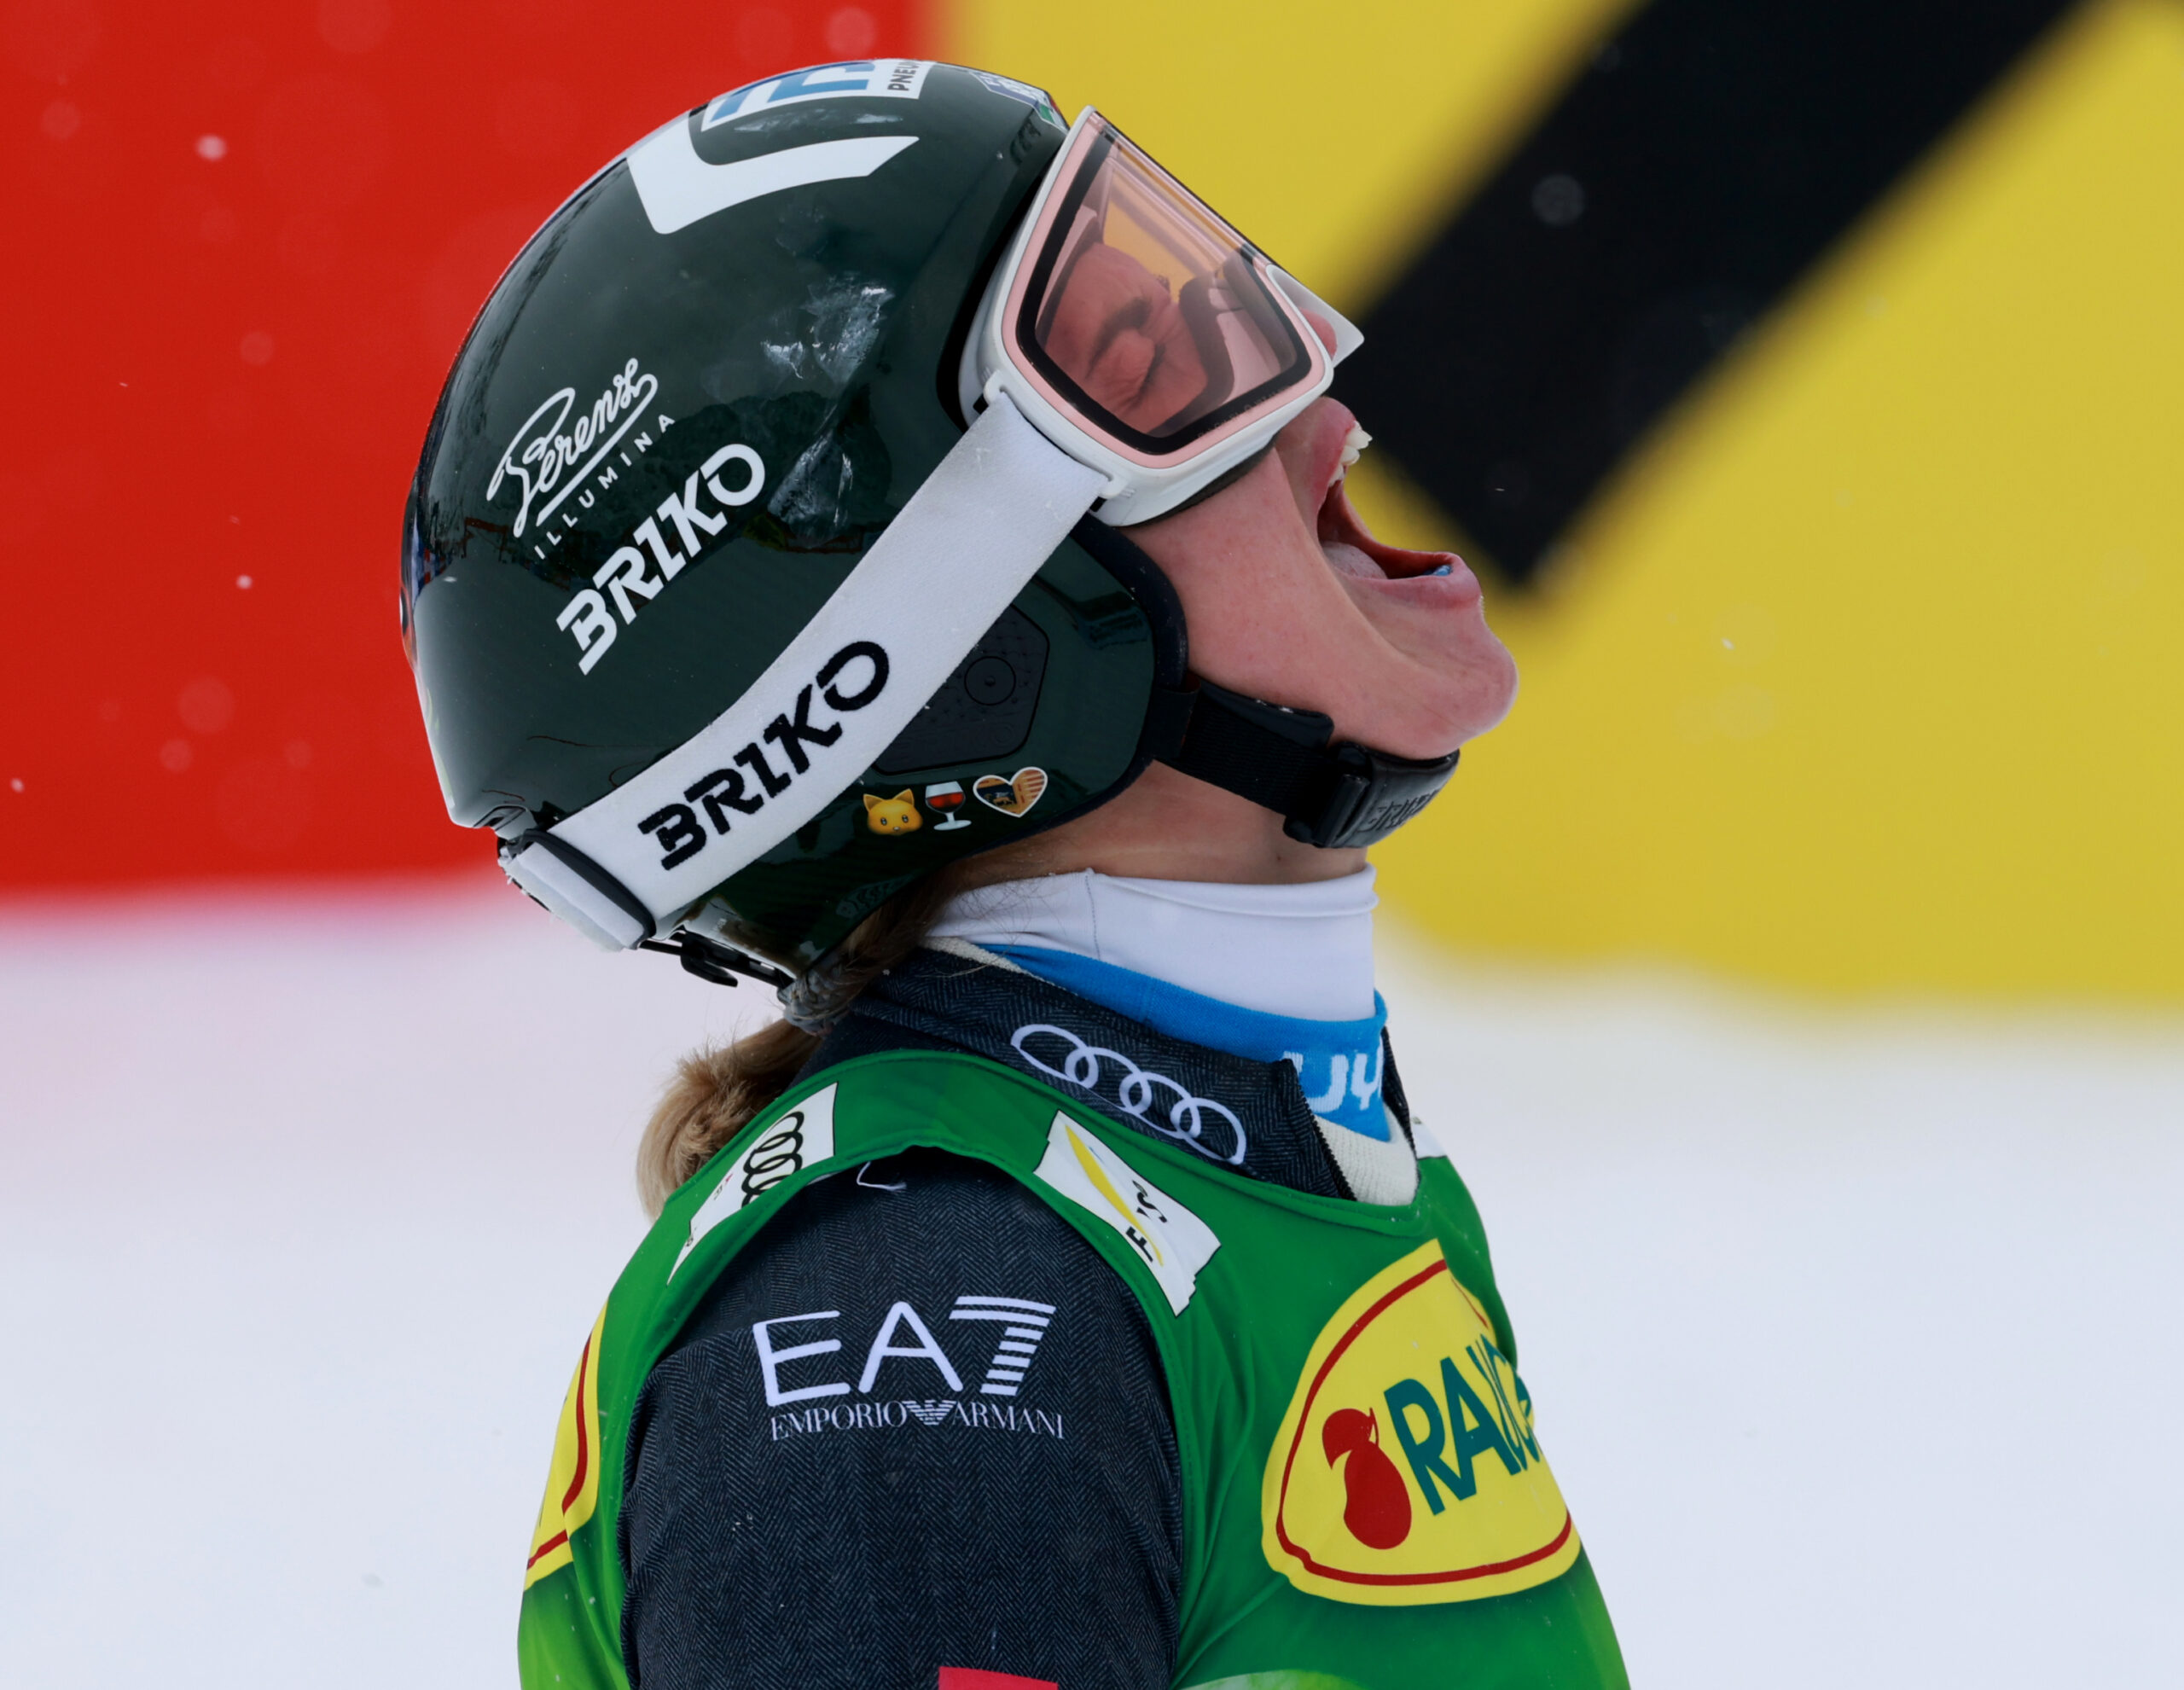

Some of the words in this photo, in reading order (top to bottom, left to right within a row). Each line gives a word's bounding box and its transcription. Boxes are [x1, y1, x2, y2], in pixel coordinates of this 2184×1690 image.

[534, 414, 676, 560] ILLUMINA
[556, 443, 765, 676] BRIKO
[638, 641, 890, 871] BRIKO
[1282, 1037, 1385, 1113] UY
[752, 1295, 1057, 1408] EA7
[771, 1400, 907, 1441] EMPORIO
[952, 1401, 1065, 1439] ARMANI
